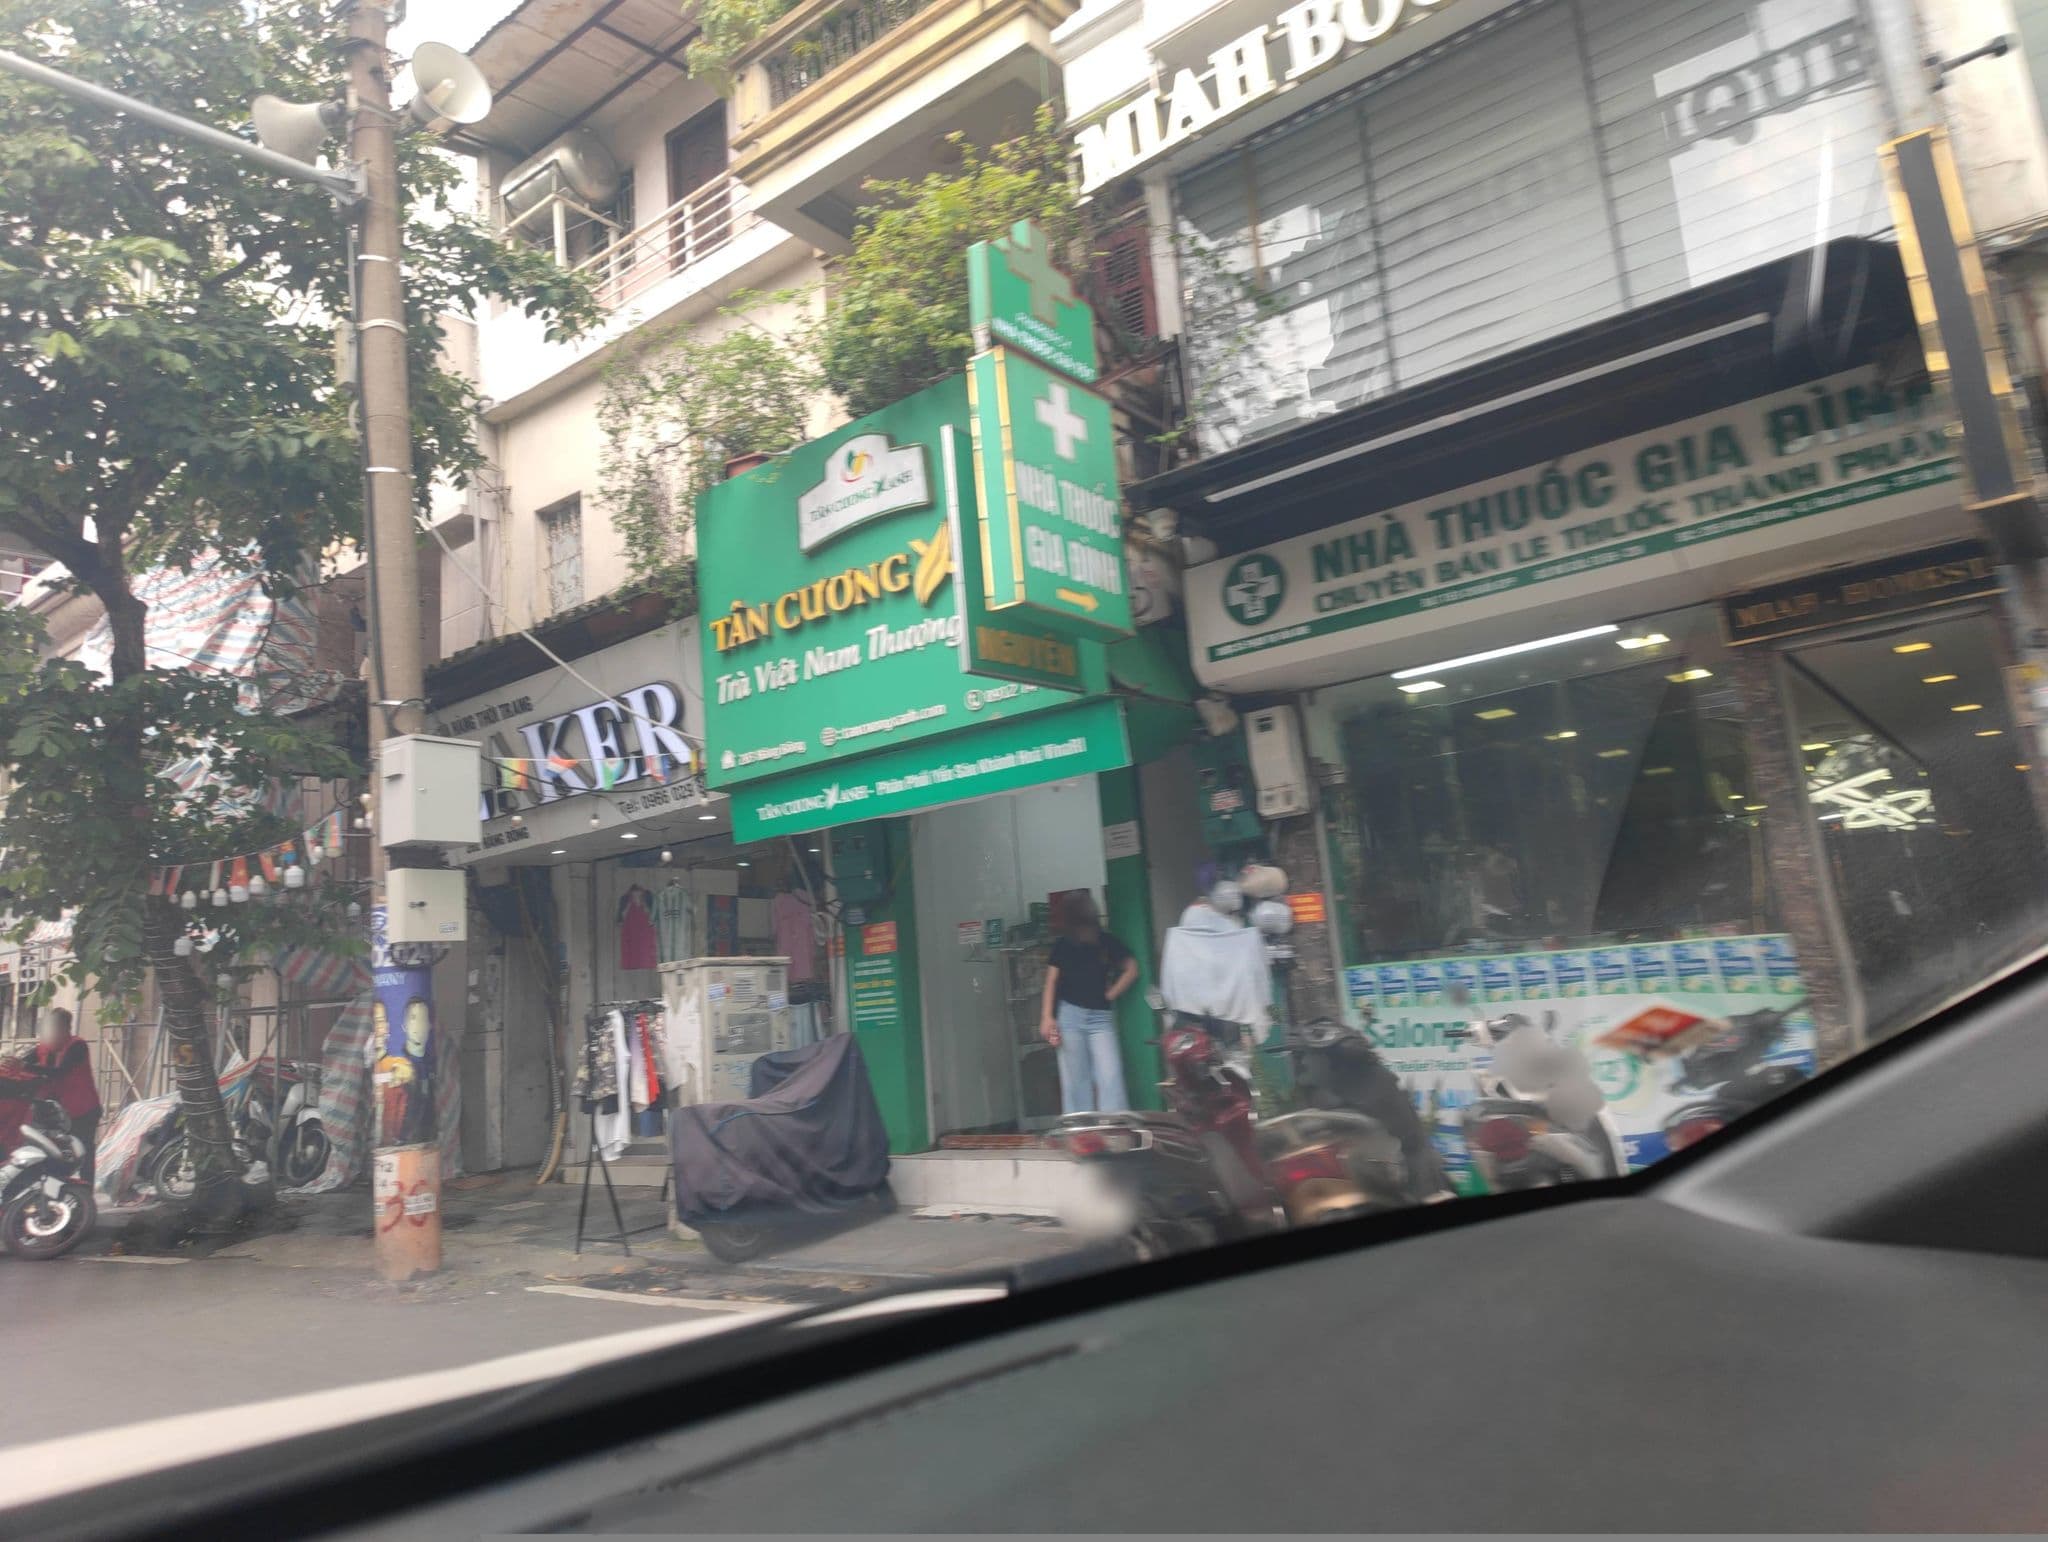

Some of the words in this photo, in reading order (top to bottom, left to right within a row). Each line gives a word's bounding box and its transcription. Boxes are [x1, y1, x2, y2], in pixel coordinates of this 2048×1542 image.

[1276, 0, 1443, 81] BO
[1309, 512, 1417, 585] NHÀ
[1426, 460, 1615, 550] THUỐC
[1633, 423, 1750, 494] GIA
[709, 599, 771, 652] TÂN
[774, 553, 911, 630] CƯƠNG
[716, 670, 753, 705] Trà
[754, 657, 800, 694] Việt
[802, 646, 863, 681] Nam
